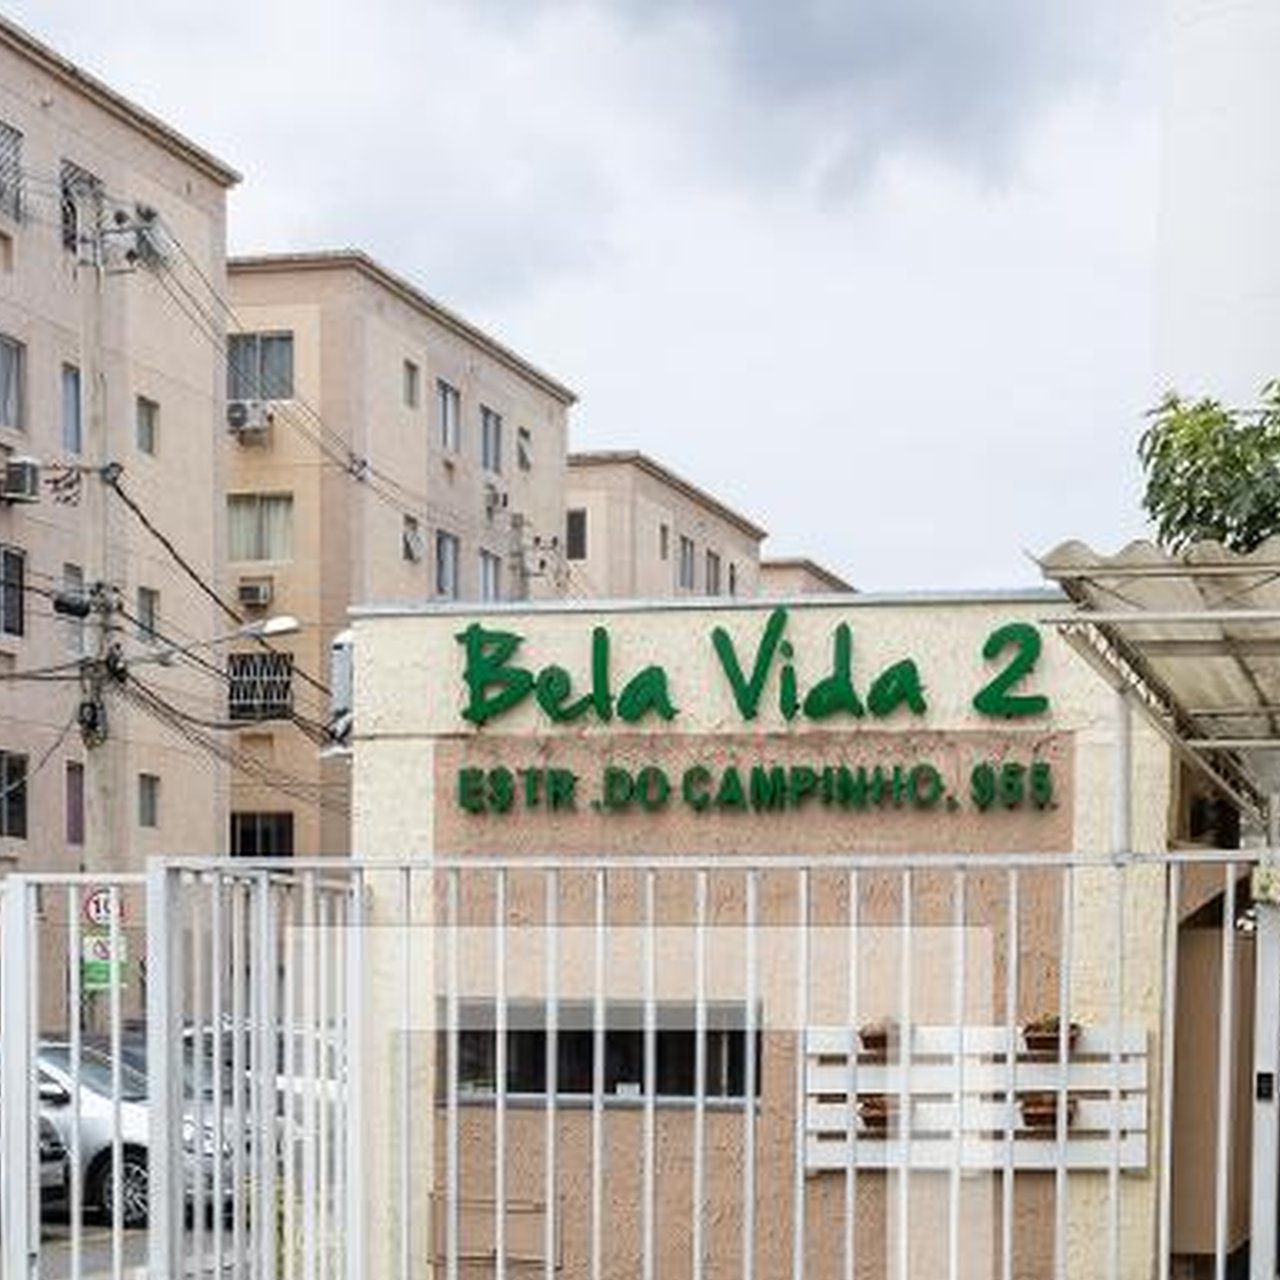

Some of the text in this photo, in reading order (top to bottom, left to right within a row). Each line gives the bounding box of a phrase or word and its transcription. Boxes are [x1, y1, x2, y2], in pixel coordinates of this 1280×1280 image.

[455, 605, 1050, 724] Bela Vida 2
